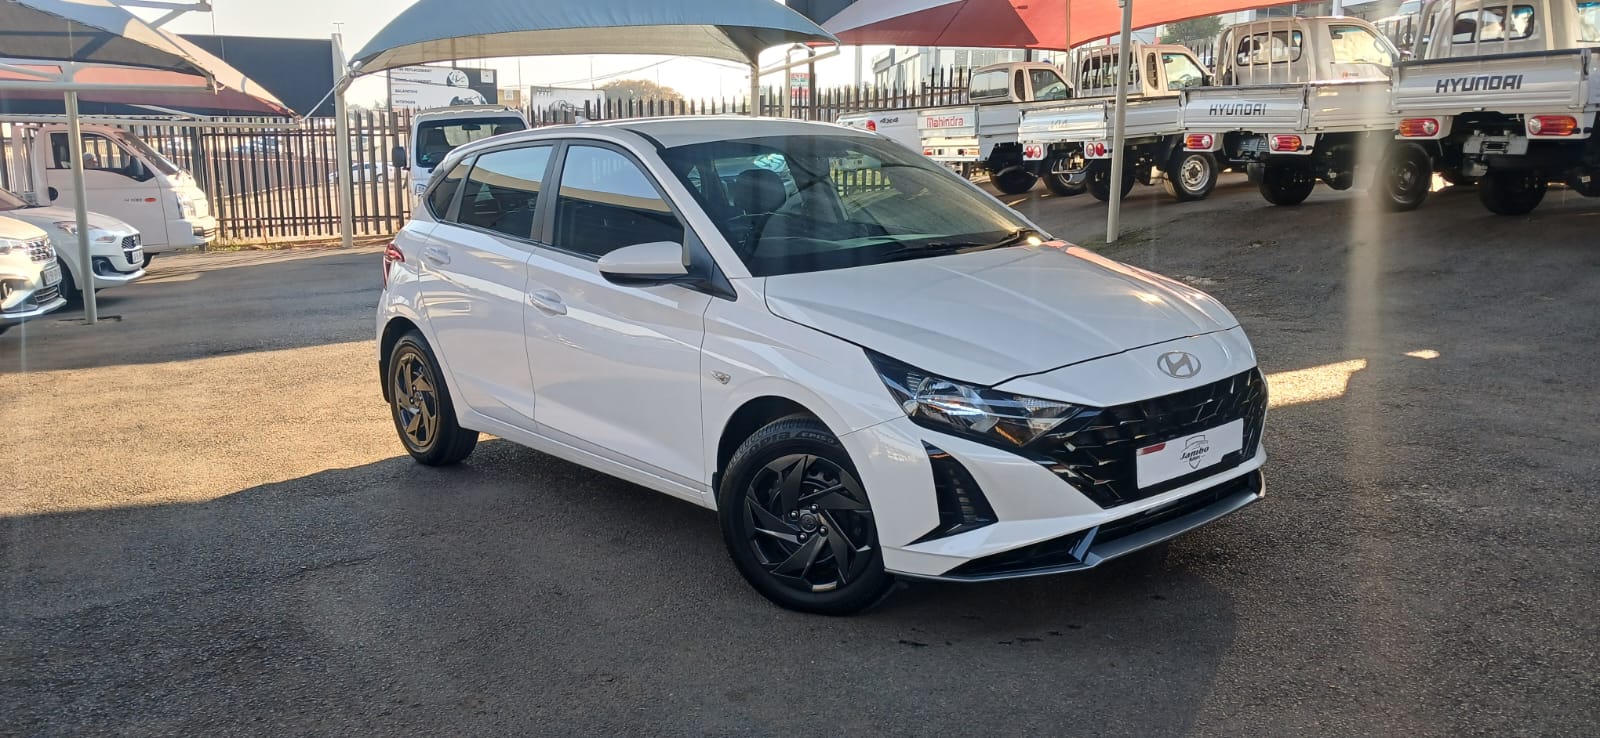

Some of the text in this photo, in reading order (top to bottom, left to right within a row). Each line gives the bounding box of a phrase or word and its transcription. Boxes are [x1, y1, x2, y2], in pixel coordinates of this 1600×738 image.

[1436, 75, 1523, 93] HYUNDAI
[1209, 103, 1266, 115] HYUNDAI
[926, 116, 964, 128] Mahindra
[1180, 446, 1209, 460] Jambo
